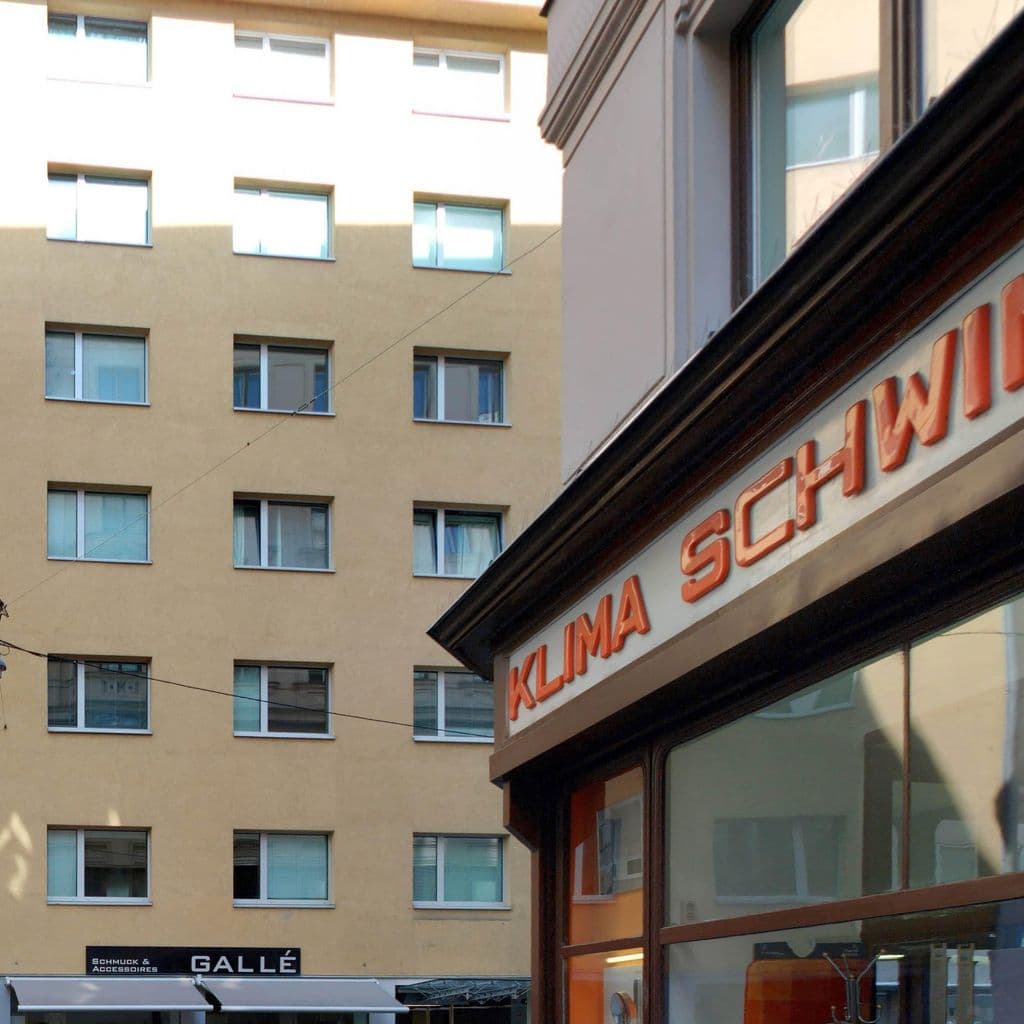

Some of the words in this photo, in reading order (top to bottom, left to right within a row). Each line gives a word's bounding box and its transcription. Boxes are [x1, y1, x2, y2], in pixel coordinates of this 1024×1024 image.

[508, 574, 651, 721] KLIMA
[142, 957, 150, 966] &
[191, 950, 297, 974] GALLÉ
